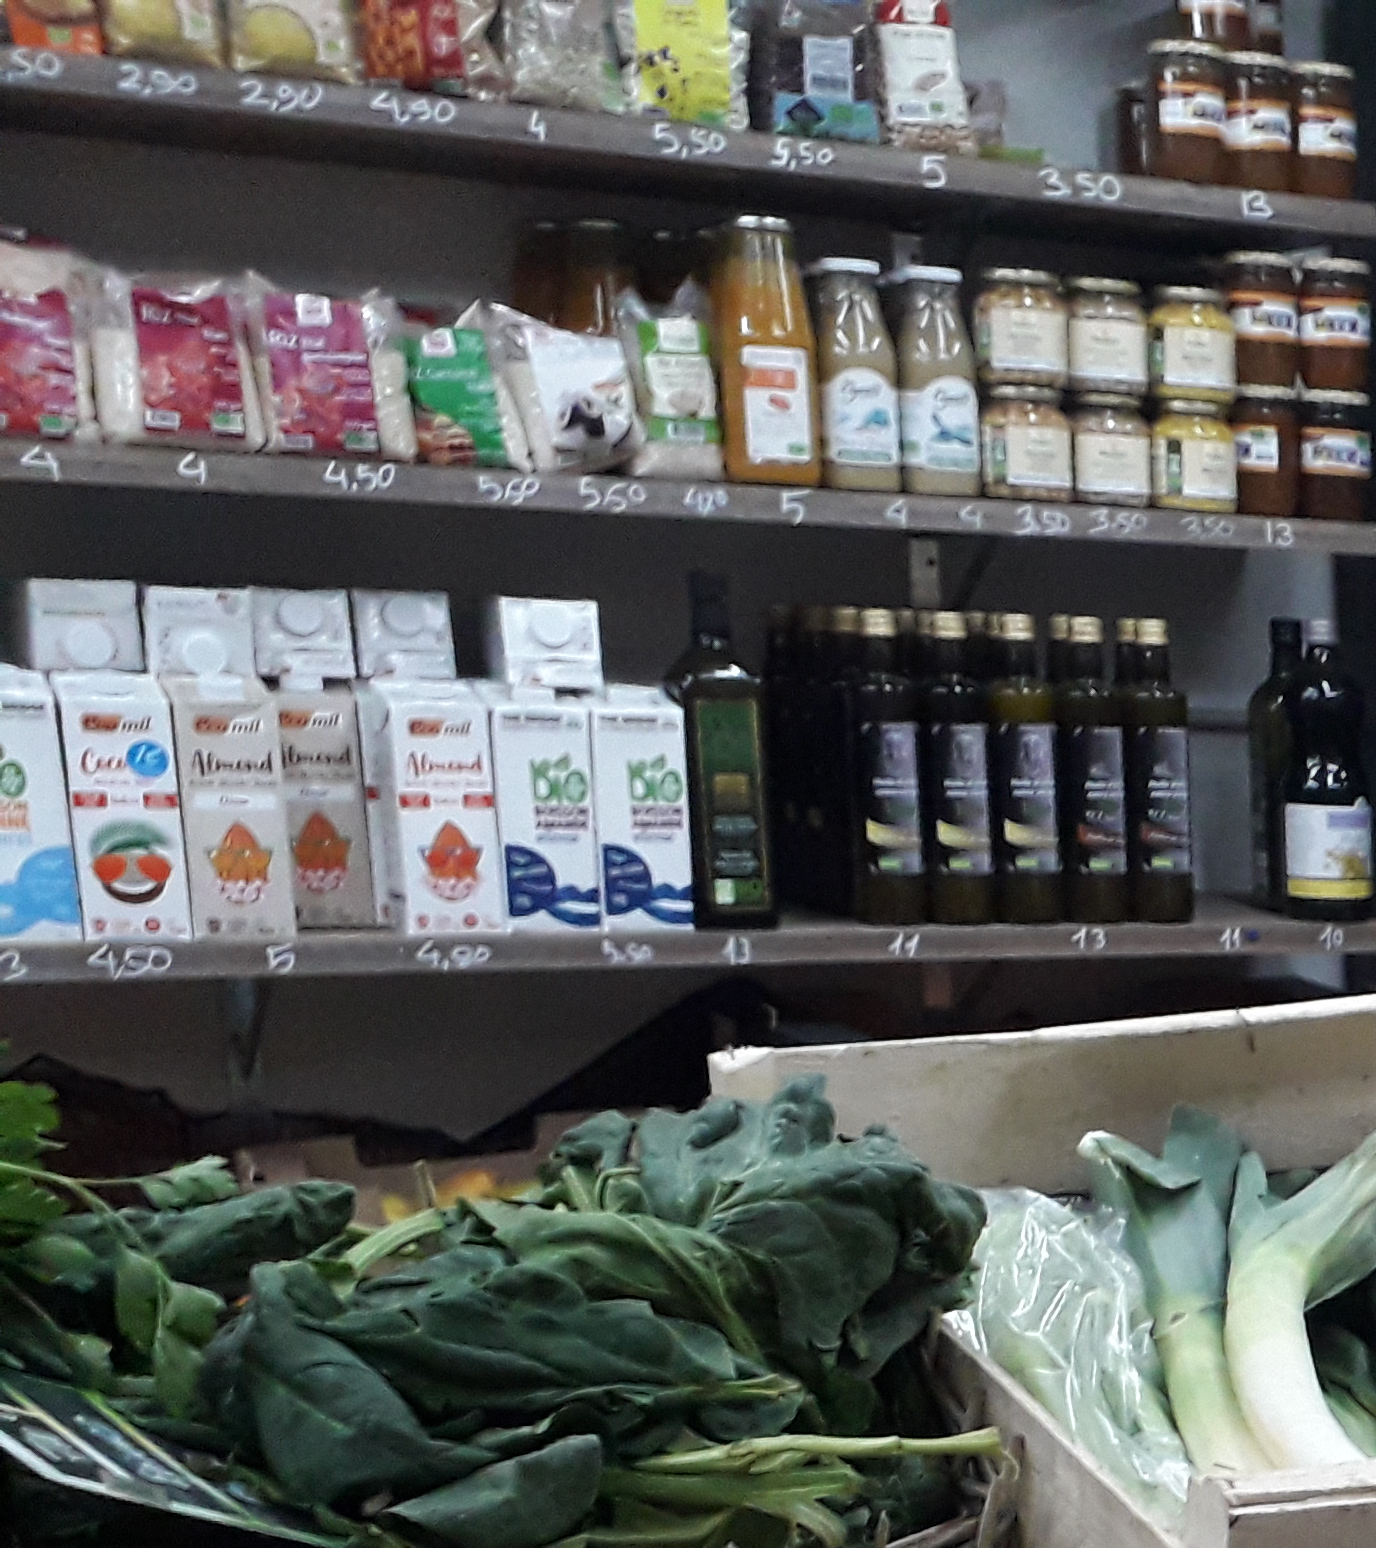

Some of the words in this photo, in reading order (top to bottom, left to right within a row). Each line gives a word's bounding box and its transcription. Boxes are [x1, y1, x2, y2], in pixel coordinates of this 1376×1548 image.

[0, 48, 61, 82] ,50
[240, 79, 323, 114] 2,90
[527, 109, 548, 142] 4
[652, 121, 727, 159] 5,50
[769, 136, 836, 171] 5,50
[919, 154, 948, 190] 5
[19, 444, 62, 482] 4
[176, 450, 209, 485] 4
[779, 488, 813, 528] 5
[883, 498, 908, 529] 4
[958, 504, 983, 530] 4
[1264, 520, 1294, 547] 13
[887, 932, 921, 959] 11
[1069, 926, 1108, 951] 13
[264, 942, 297, 976] 5
